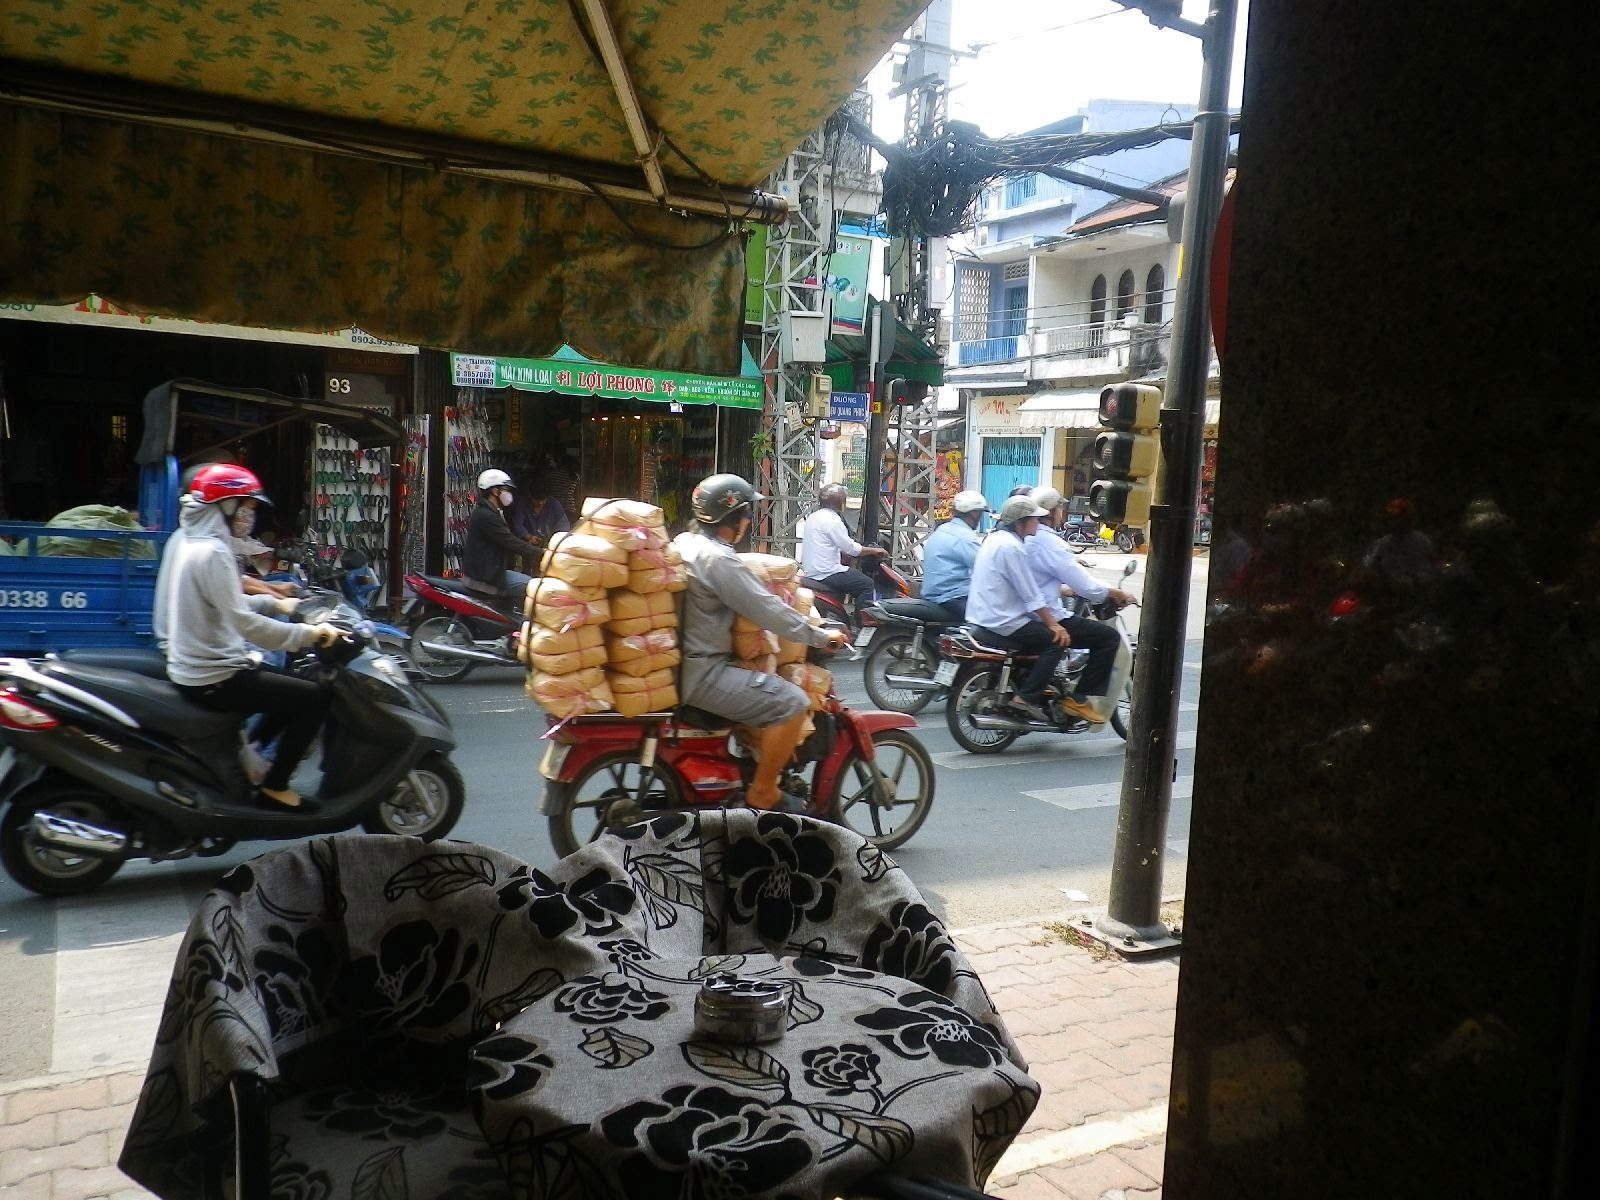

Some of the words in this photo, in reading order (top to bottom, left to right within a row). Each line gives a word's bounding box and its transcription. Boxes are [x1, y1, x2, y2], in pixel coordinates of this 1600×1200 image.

[518, 367, 533, 382] KIM
[577, 370, 602, 391] LỢI
[606, 374, 656, 394] PHONG
[329, 378, 351, 394] 93
[61, 591, 88, 609] 66
